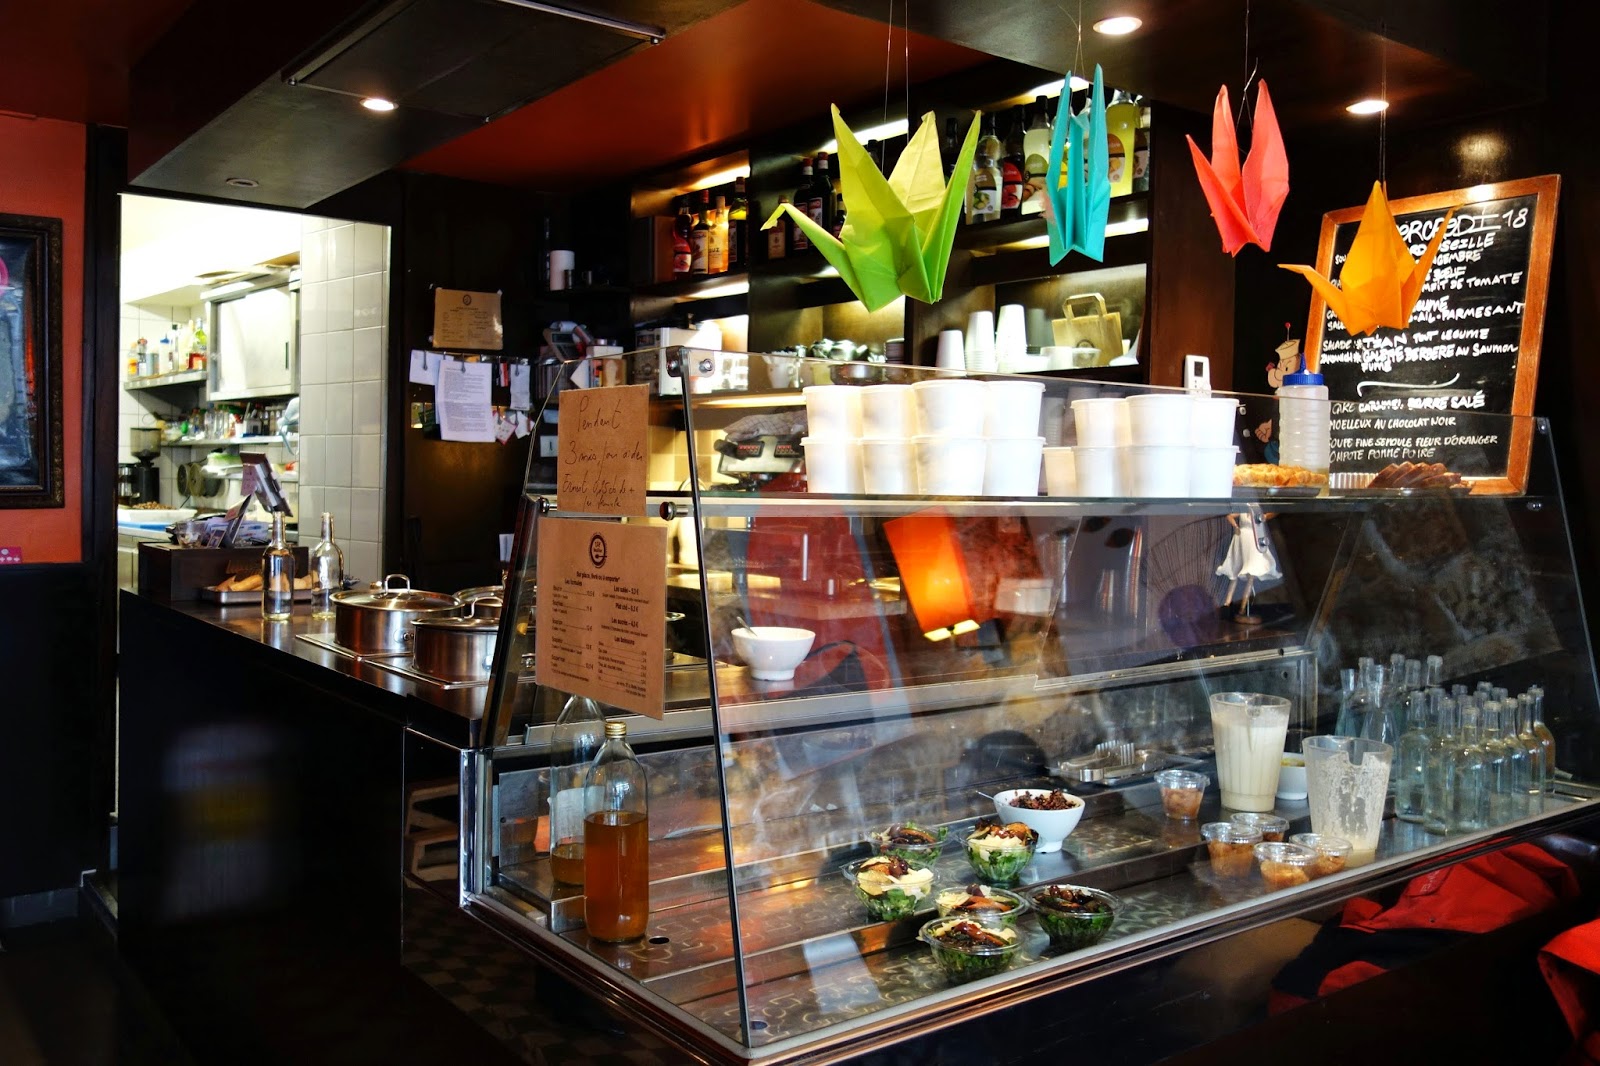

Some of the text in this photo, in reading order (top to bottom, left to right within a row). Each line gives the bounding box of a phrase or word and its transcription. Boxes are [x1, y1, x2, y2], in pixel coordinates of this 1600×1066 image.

[1502, 207, 1529, 229] 18
[1466, 271, 1523, 288] TOMATE
[1455, 345, 1470, 357] AU
[1450, 389, 1486, 409] SALÉ
[1374, 418, 1386, 430] AU
[1387, 417, 1430, 430] CHOCOLAT
[1430, 415, 1457, 427] NOIR
[1355, 437, 1374, 448] FINE
[1415, 436, 1442, 448] FLEUR
[565, 440, 577, 465] 3
[1367, 447, 1401, 460] POMME
[1401, 447, 1436, 459] POIRE
